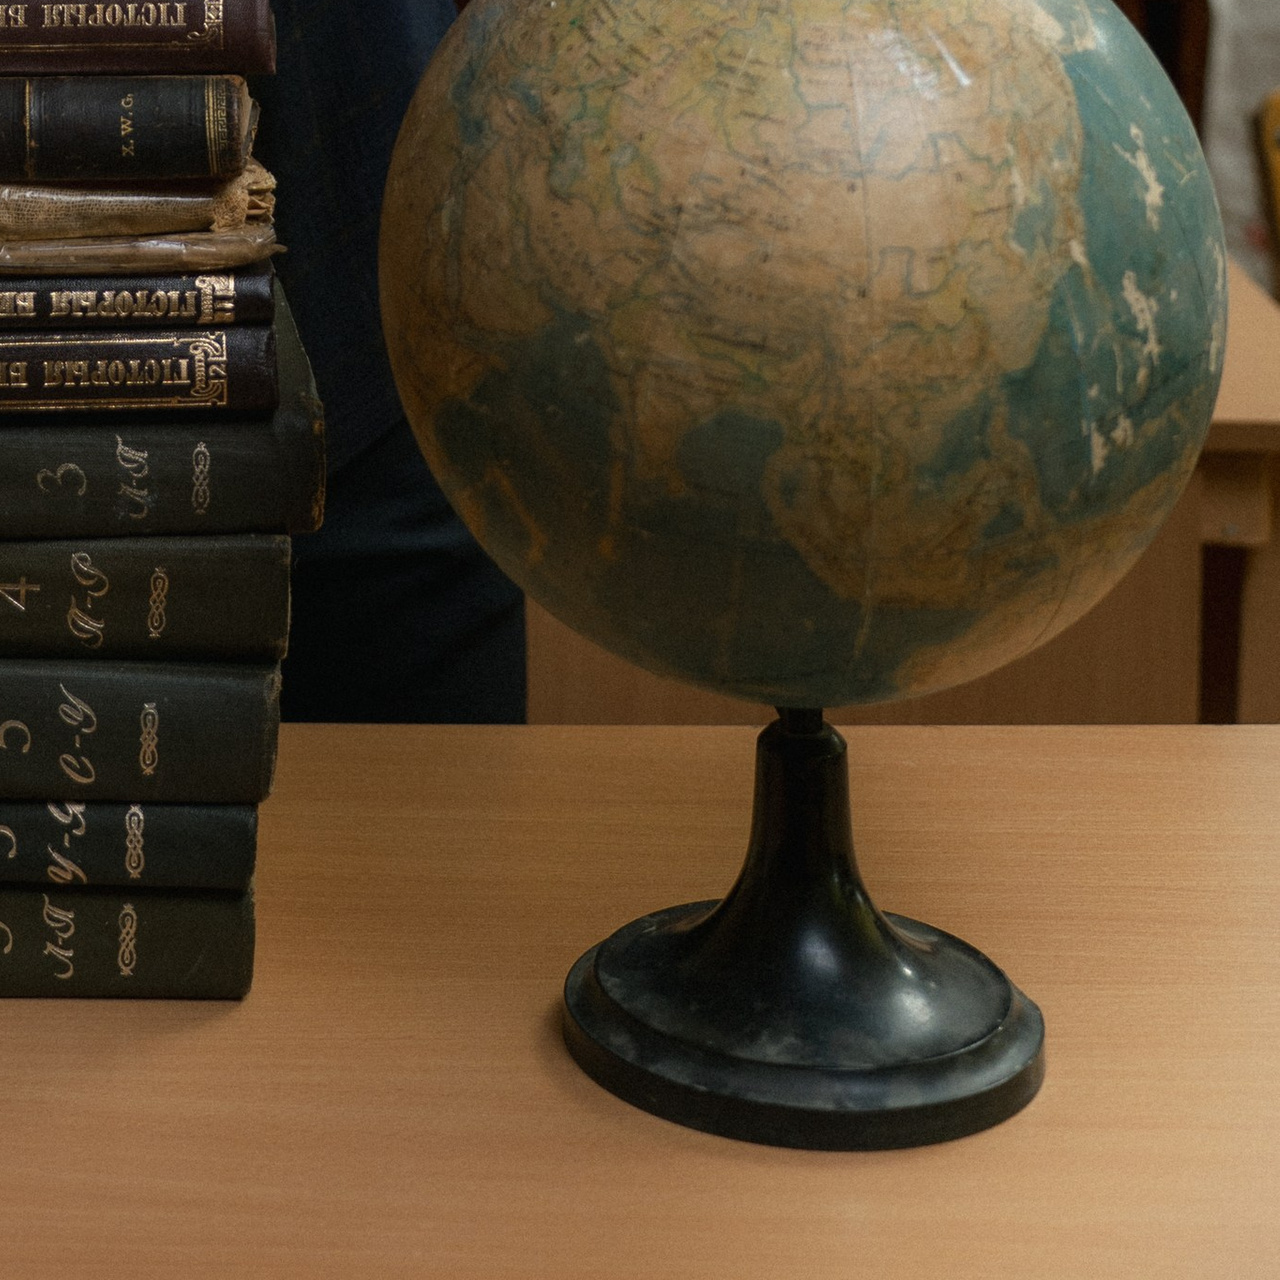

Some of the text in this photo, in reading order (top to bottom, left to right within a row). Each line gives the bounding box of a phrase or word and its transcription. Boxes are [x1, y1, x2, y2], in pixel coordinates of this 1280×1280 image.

[41, 2, 187, 29] ГІСТОРЫЯ
[49, 290, 197, 318] ГІСТОРЫЯ
[43, 358, 191, 387] ГІСТОРЫЯ
[37, 462, 87, 496] 3
